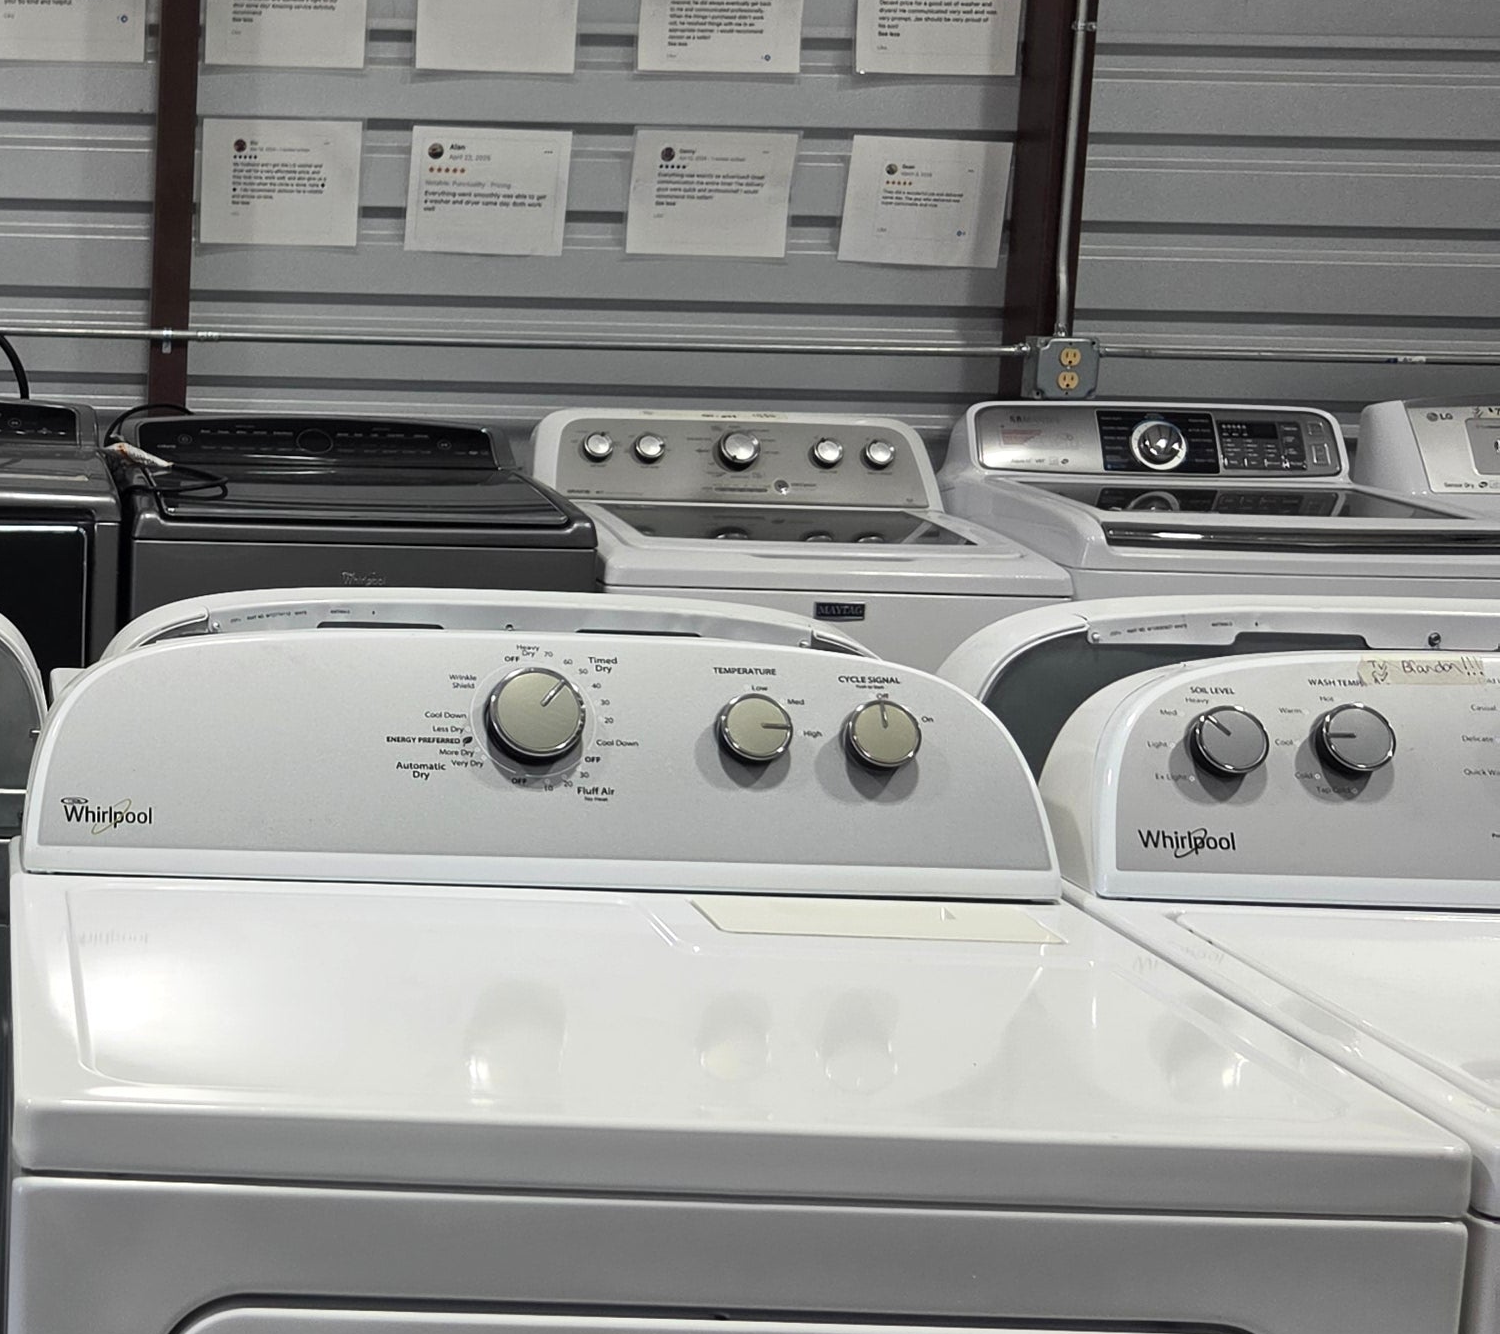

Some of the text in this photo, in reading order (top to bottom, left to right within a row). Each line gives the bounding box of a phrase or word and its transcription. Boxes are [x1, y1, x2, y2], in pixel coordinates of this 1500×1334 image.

[817, 605, 863, 615] MAYTAG
[588, 656, 618, 665] Timed
[595, 665, 612, 674] Dry
[713, 667, 777, 676] TEMPERATURE
[838, 675, 900, 685] CYCLE SIGNAL
[1308, 678, 1336, 686] WASH
[1190, 686, 1235, 695] SOIL LEVEL
[787, 698, 805, 706] Med
[450, 726, 464, 734] Dry
[803, 730, 822, 738] High
[386, 736, 461, 744] ENERGY PREFERRED
[460, 749, 475, 757] Dry
[396, 761, 446, 771] Automatic
[451, 760, 484, 769] Very Dry
[412, 770, 430, 780] Dry
[577, 786, 615, 796] Fluff Air
[63, 801, 153, 832] Whirlpool
[1137, 828, 1236, 858] Whirlpool
